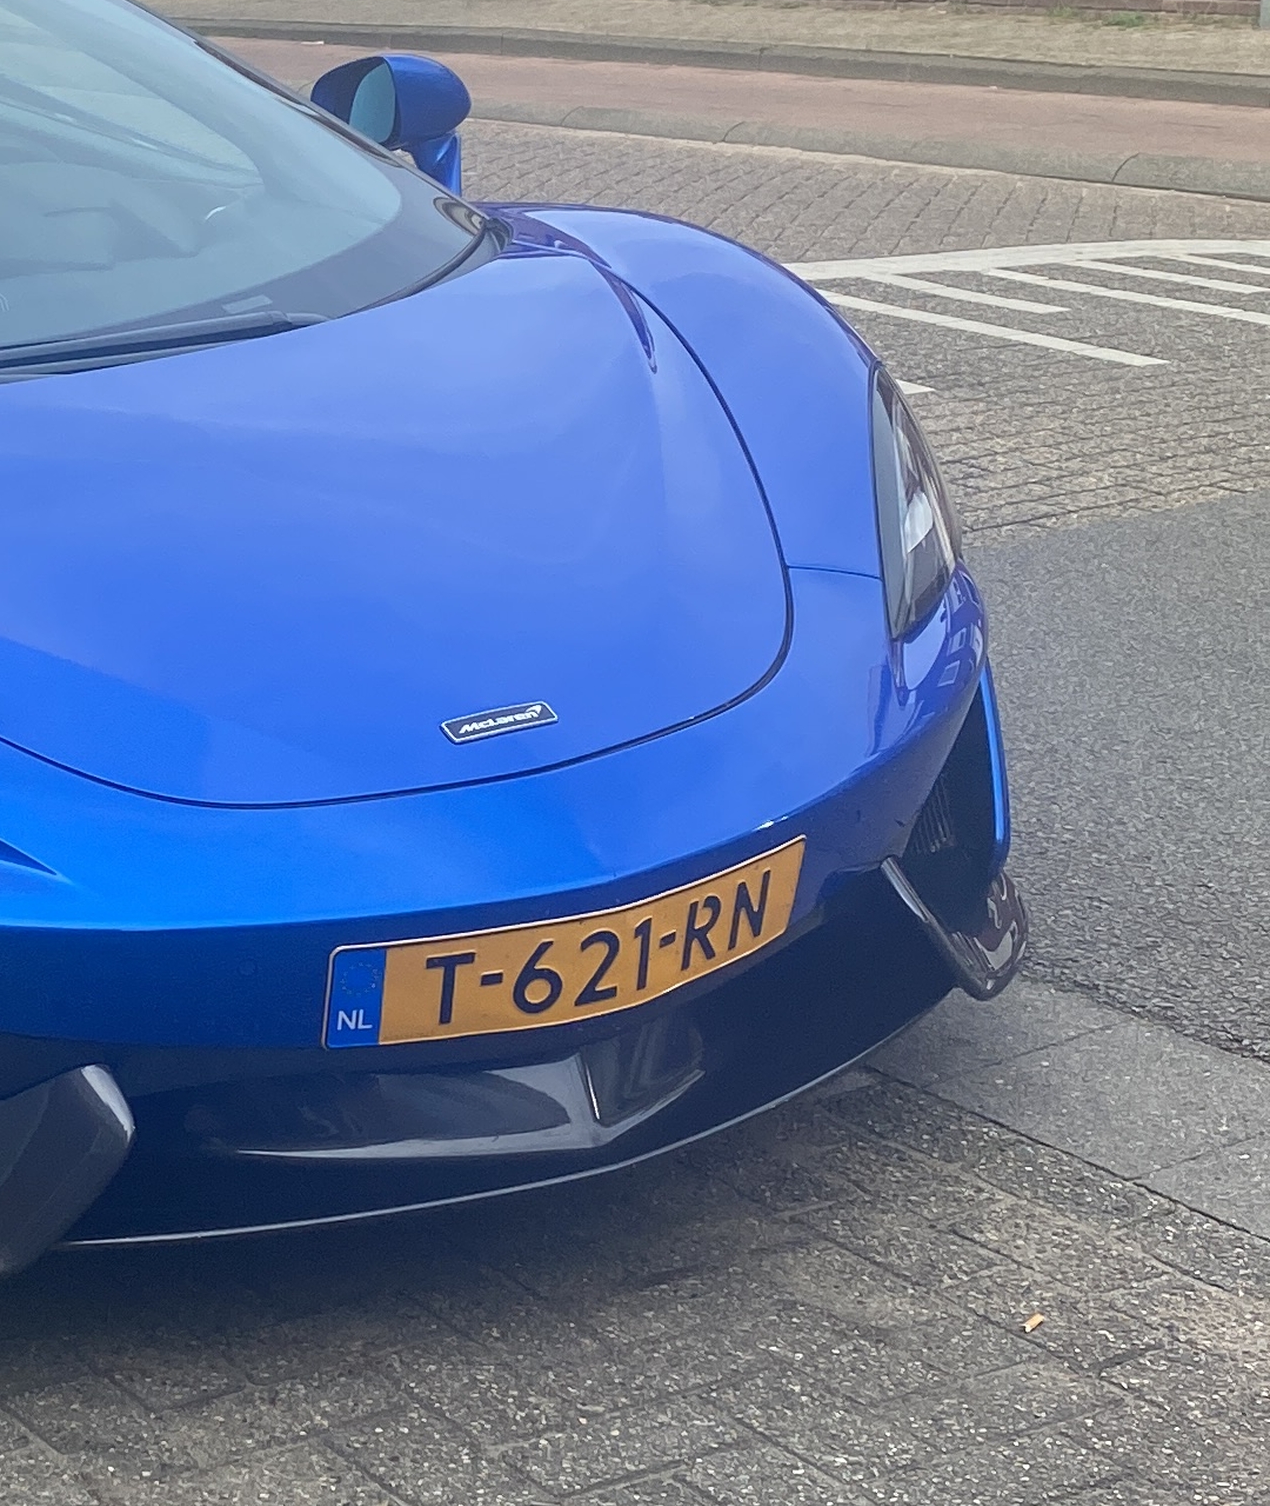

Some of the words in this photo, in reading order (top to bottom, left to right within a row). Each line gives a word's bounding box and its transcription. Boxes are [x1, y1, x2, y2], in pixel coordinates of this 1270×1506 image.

[459, 710, 539, 734] McLaren
[336, 1009, 373, 1032] NL
[425, 869, 772, 1026] T-621-RN
